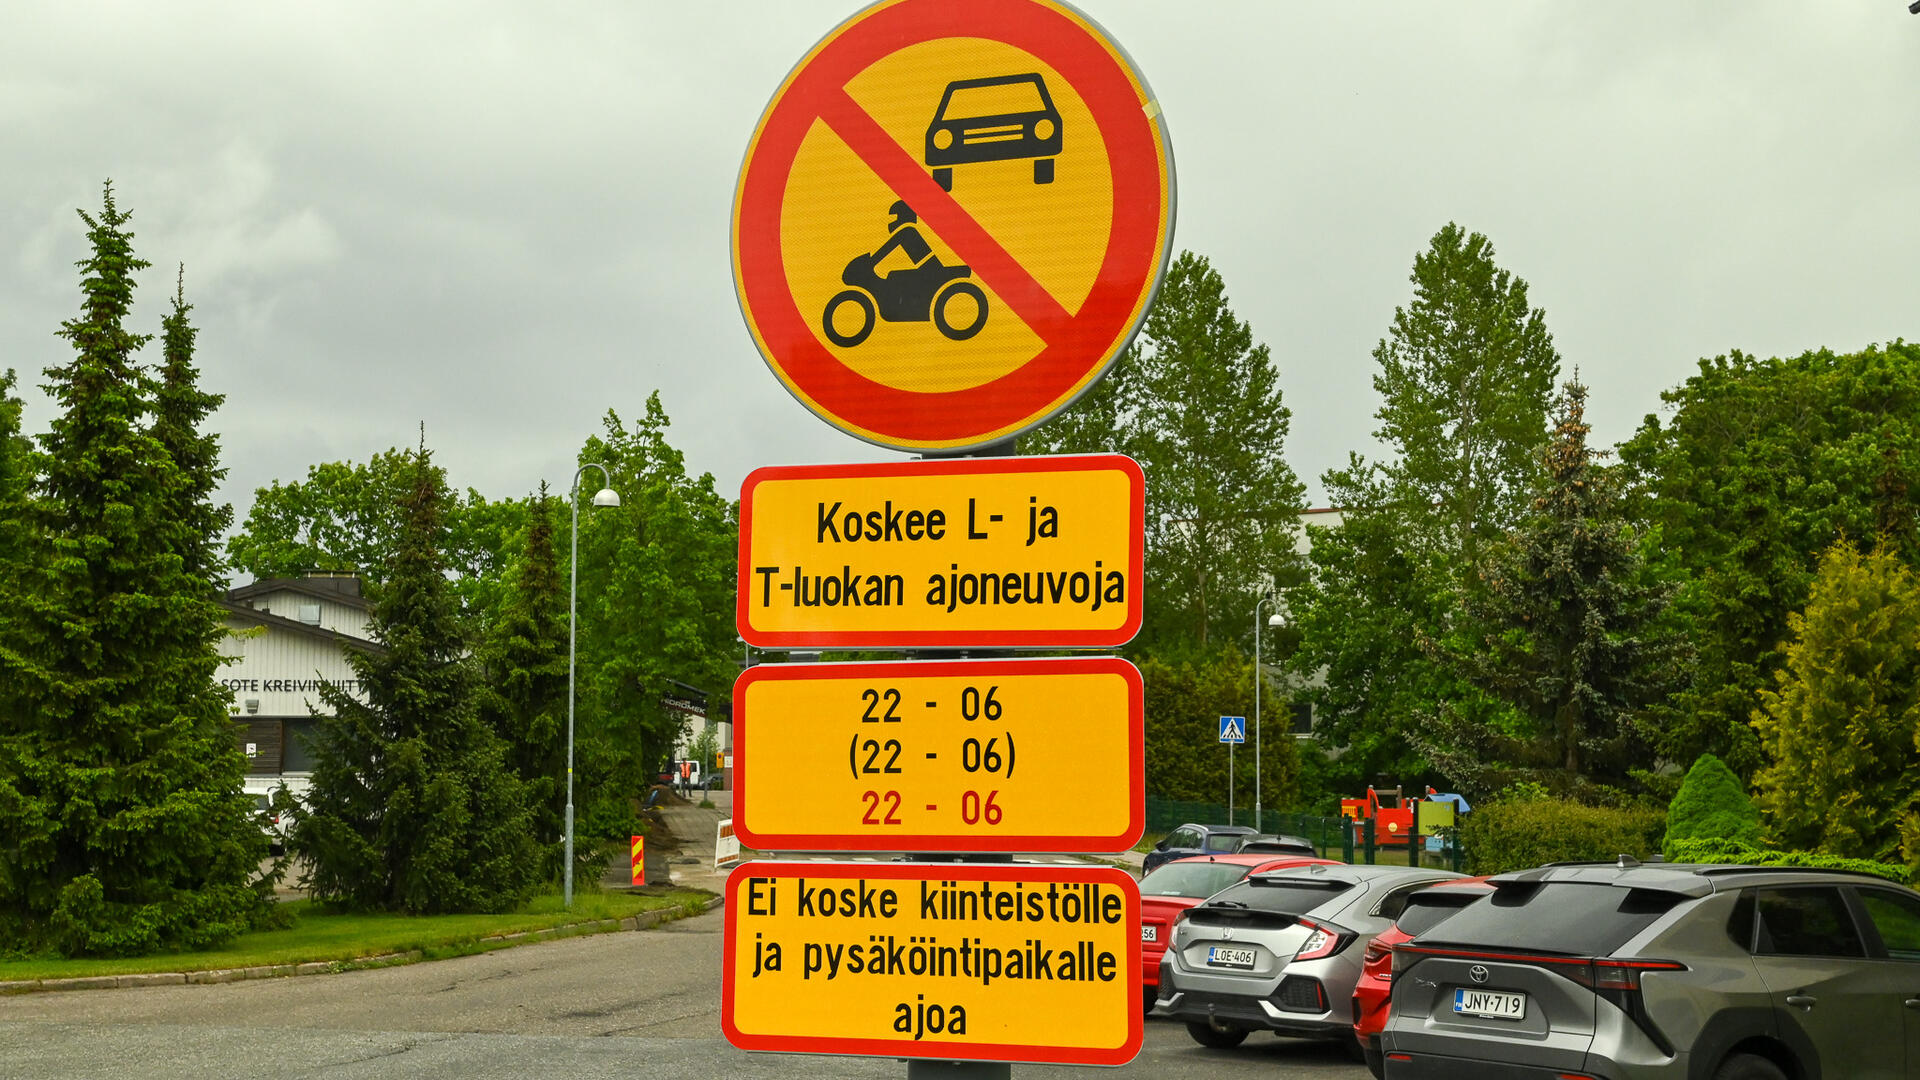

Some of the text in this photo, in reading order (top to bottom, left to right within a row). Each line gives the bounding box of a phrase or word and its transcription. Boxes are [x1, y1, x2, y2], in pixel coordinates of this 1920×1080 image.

[817, 496, 1058, 547] Koskee L- ja
[755, 560, 1125, 613] T-luokan ajoneuvoja
[221, 679, 259, 692] SOTE
[861, 688, 902, 723] 22
[961, 686, 1002, 722] 06
[849, 733, 902, 780] (22
[962, 731, 1016, 779] 06)
[861, 790, 902, 825] 22
[961, 790, 1003, 826] 06
[748, 877, 1122, 924] Ei koske kiinteistölle
[752, 932, 1116, 986] ja pysäköintipaikalle
[1214, 949, 1252, 963] LOE-406
[893, 993, 966, 1041] ajoa
[1465, 993, 1521, 1013] JNY-719
